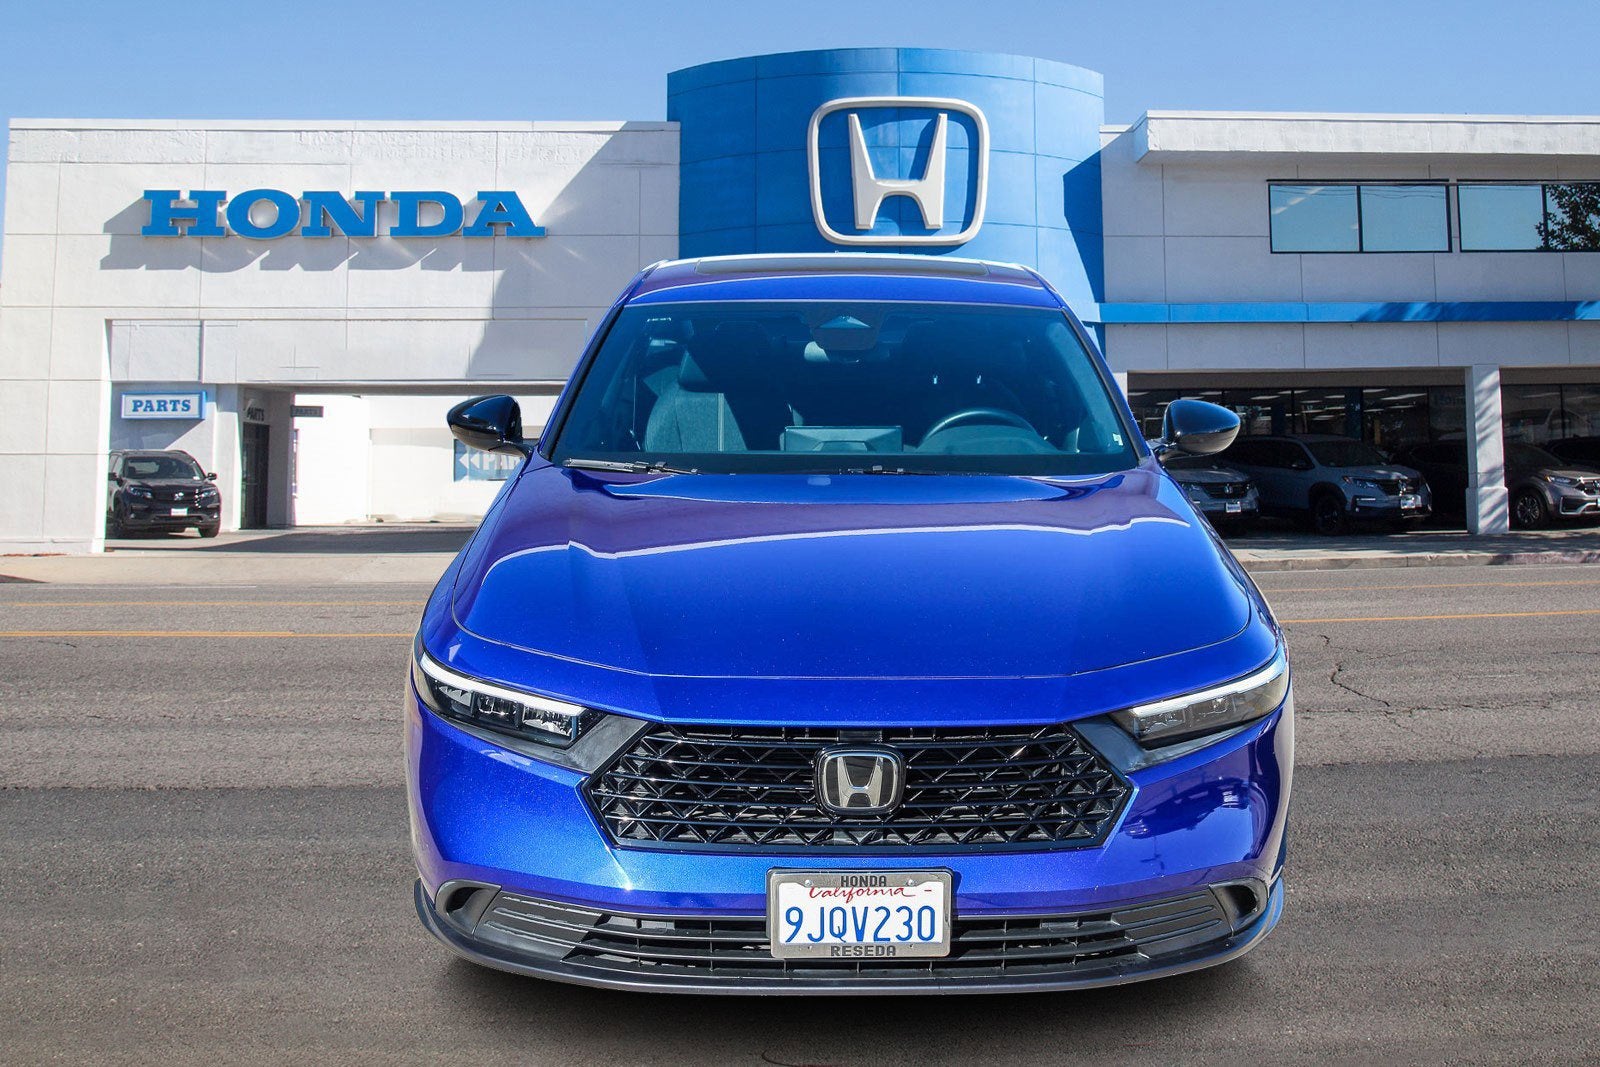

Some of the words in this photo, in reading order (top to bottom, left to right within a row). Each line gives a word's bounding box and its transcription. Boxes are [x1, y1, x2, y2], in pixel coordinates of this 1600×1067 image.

[141, 188, 548, 239] HONDA
[131, 399, 192, 412] PARTS
[840, 875, 887, 887] HONDA
[809, 886, 916, 904] California
[785, 905, 936, 943] 9JQV230
[830, 945, 897, 957] RESEDA
